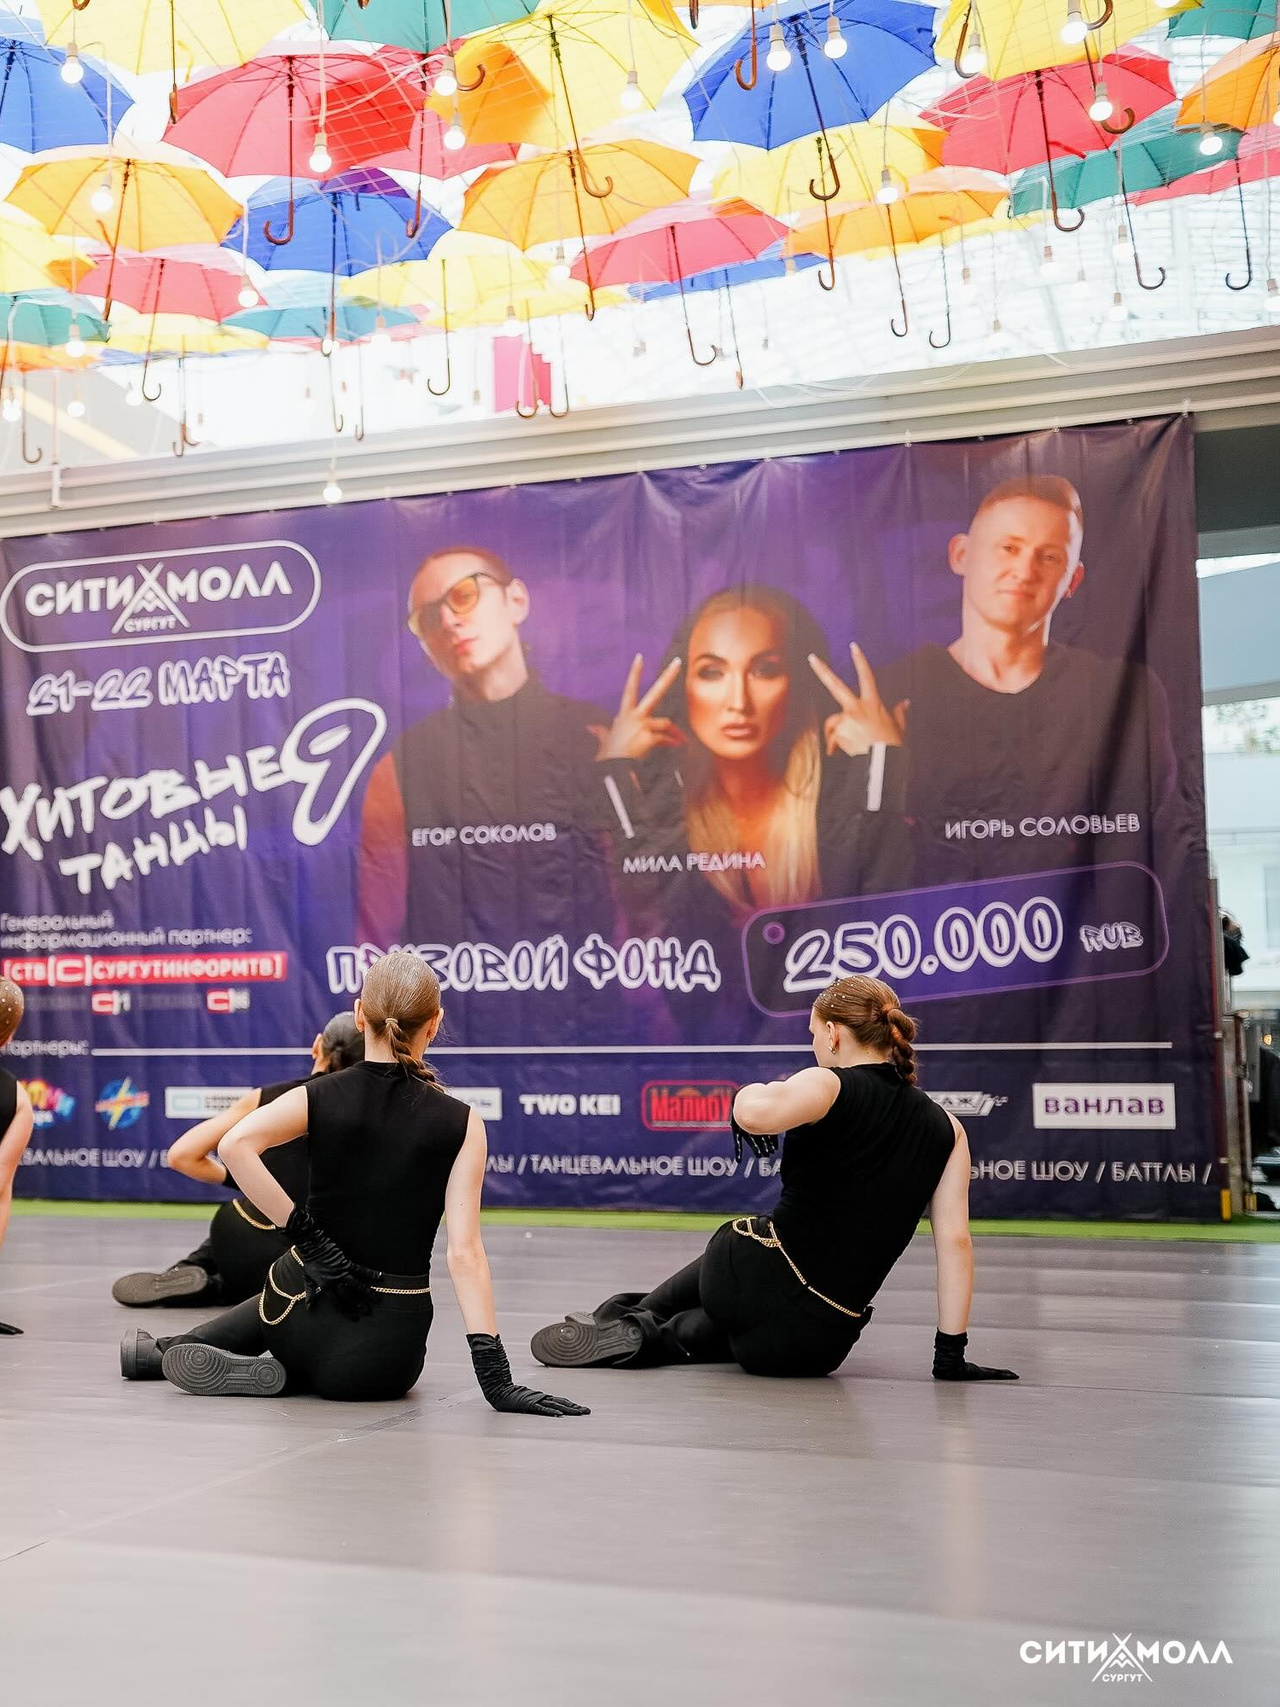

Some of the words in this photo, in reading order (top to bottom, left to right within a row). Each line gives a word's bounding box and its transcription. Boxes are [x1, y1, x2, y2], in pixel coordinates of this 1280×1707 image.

[26, 667, 152, 716] 21-22
[158, 651, 290, 707] МАРТА
[412, 827, 457, 847] ЕГОР
[459, 822, 557, 845] СОКОЛОВ
[945, 818, 1015, 840] ИГОРЬ
[1020, 813, 1141, 837] СОЛОВЬЕВ
[622, 853, 683, 874] МИЛА
[686, 851, 766, 873] РЕДИНА
[0, 909, 114, 932] Генеральный
[0, 926, 166, 951] информационный
[168, 927, 253, 948] партнер:
[783, 896, 1063, 993] 250.000
[1079, 921, 1144, 953] RUB
[326, 933, 569, 993] ПРЗОВОЙ
[573, 933, 721, 993] ФОНД
[519, 1094, 577, 1115] TWO
[579, 1094, 620, 1115] KEI
[1044, 1096, 1166, 1116] ванлав
[102, 1148, 144, 1167] ШОУ
[530, 1154, 684, 1176] ТАНЦЕВАЛЬНОЕ
[687, 1156, 738, 1177] ШОУ
[1031, 1161, 1088, 1182] ШОУ
[1112, 1161, 1196, 1183] БАТТЛЫ
